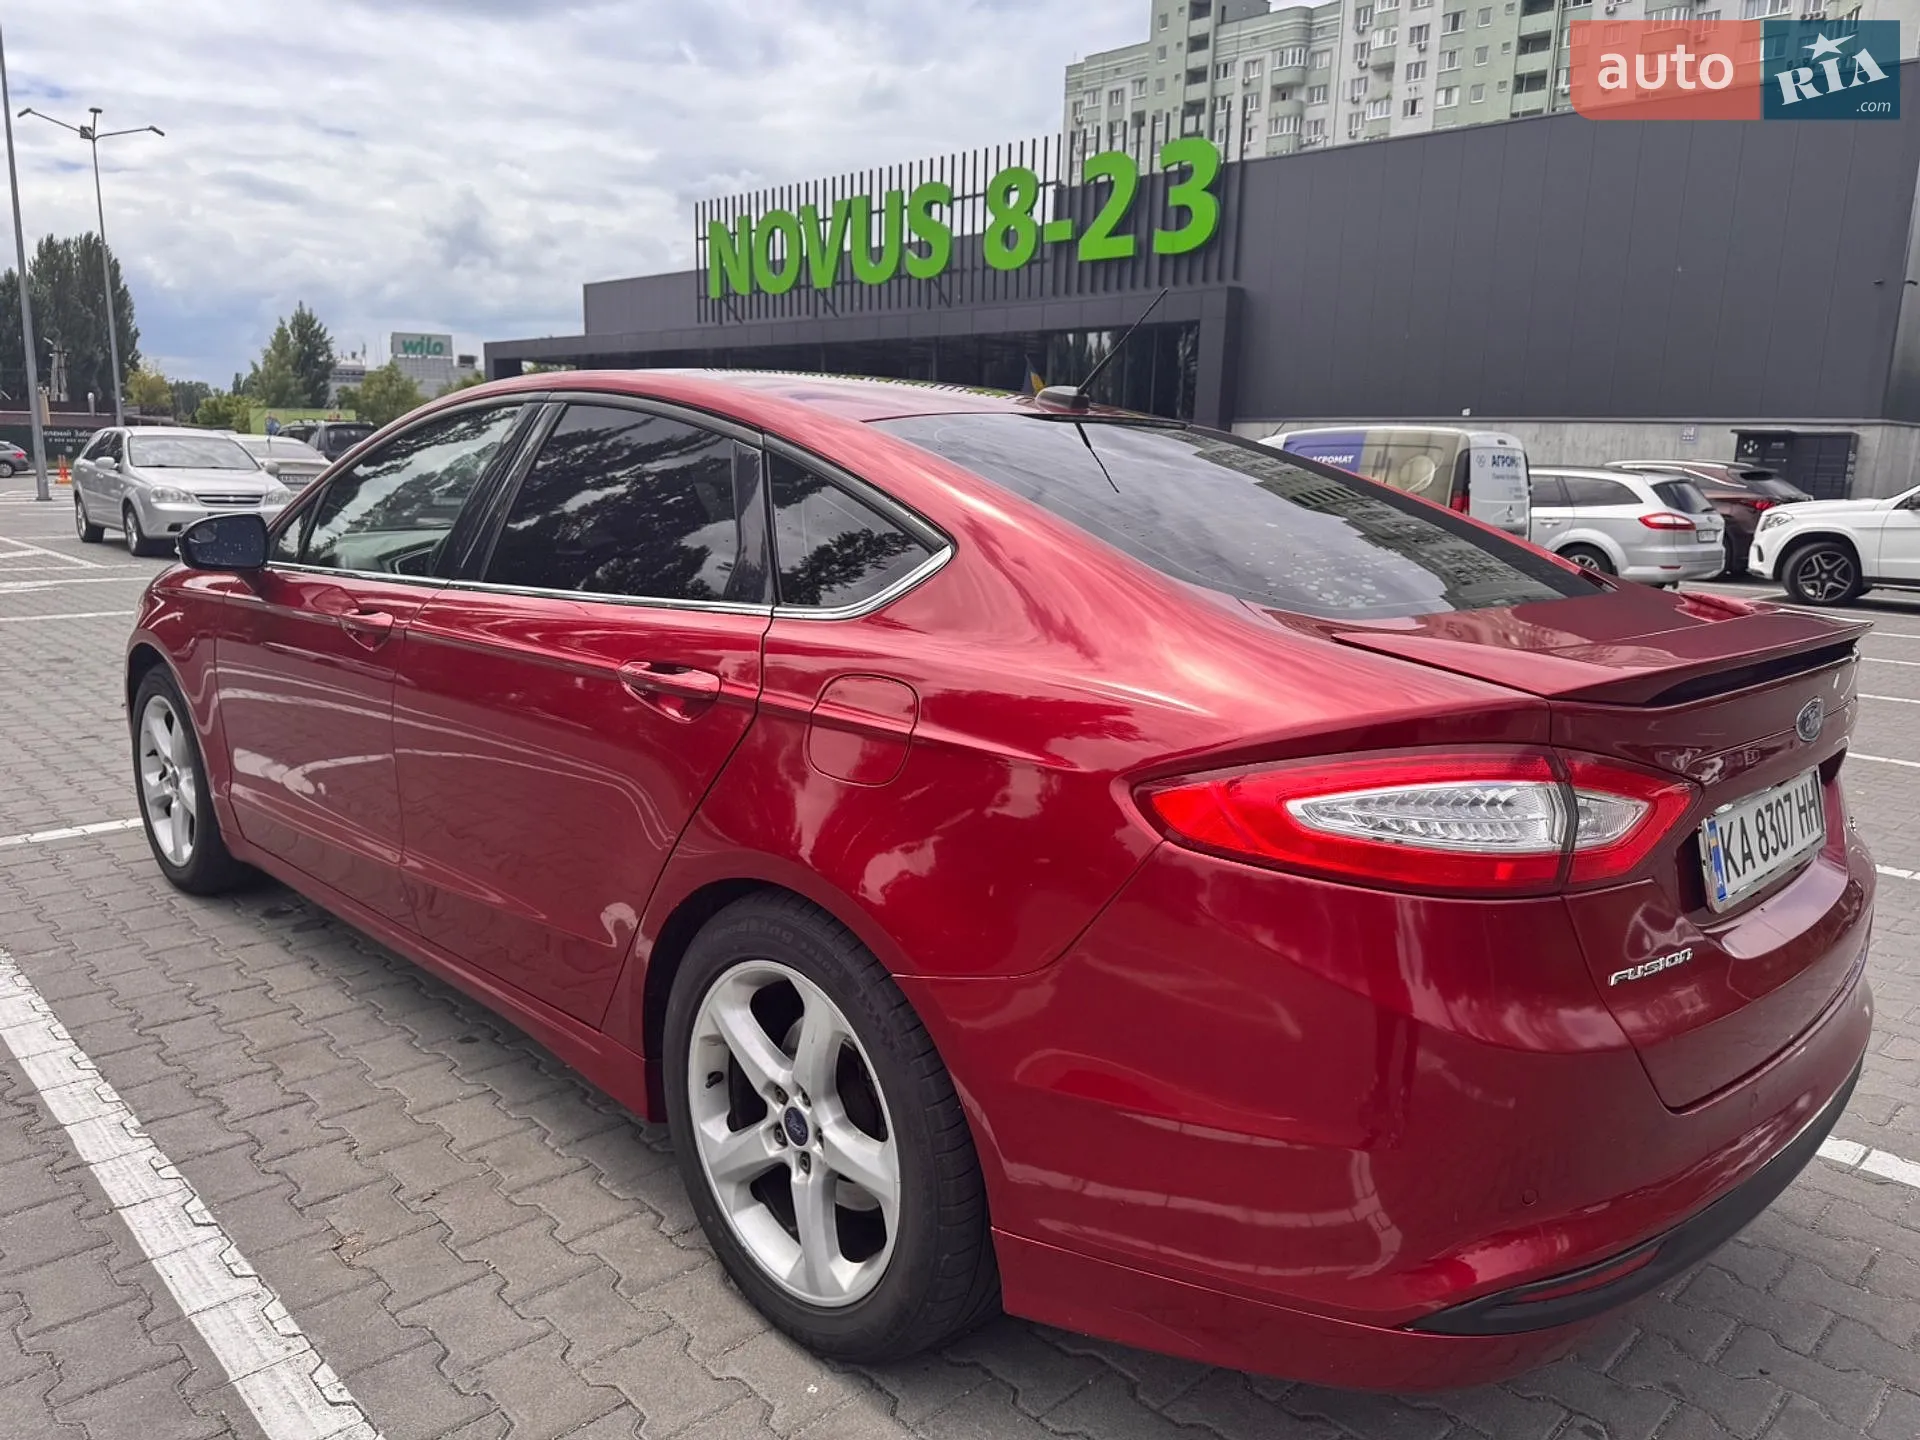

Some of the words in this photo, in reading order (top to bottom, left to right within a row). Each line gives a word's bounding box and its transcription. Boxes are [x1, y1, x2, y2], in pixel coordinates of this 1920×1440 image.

[708, 181, 953, 299] NOVUS
[983, 136, 1222, 271] 8-23
[402, 336, 444, 355] wilo
[1721, 819, 1756, 883] KA
[1758, 791, 1794, 862] 8307
[1798, 779, 1820, 839] HH
